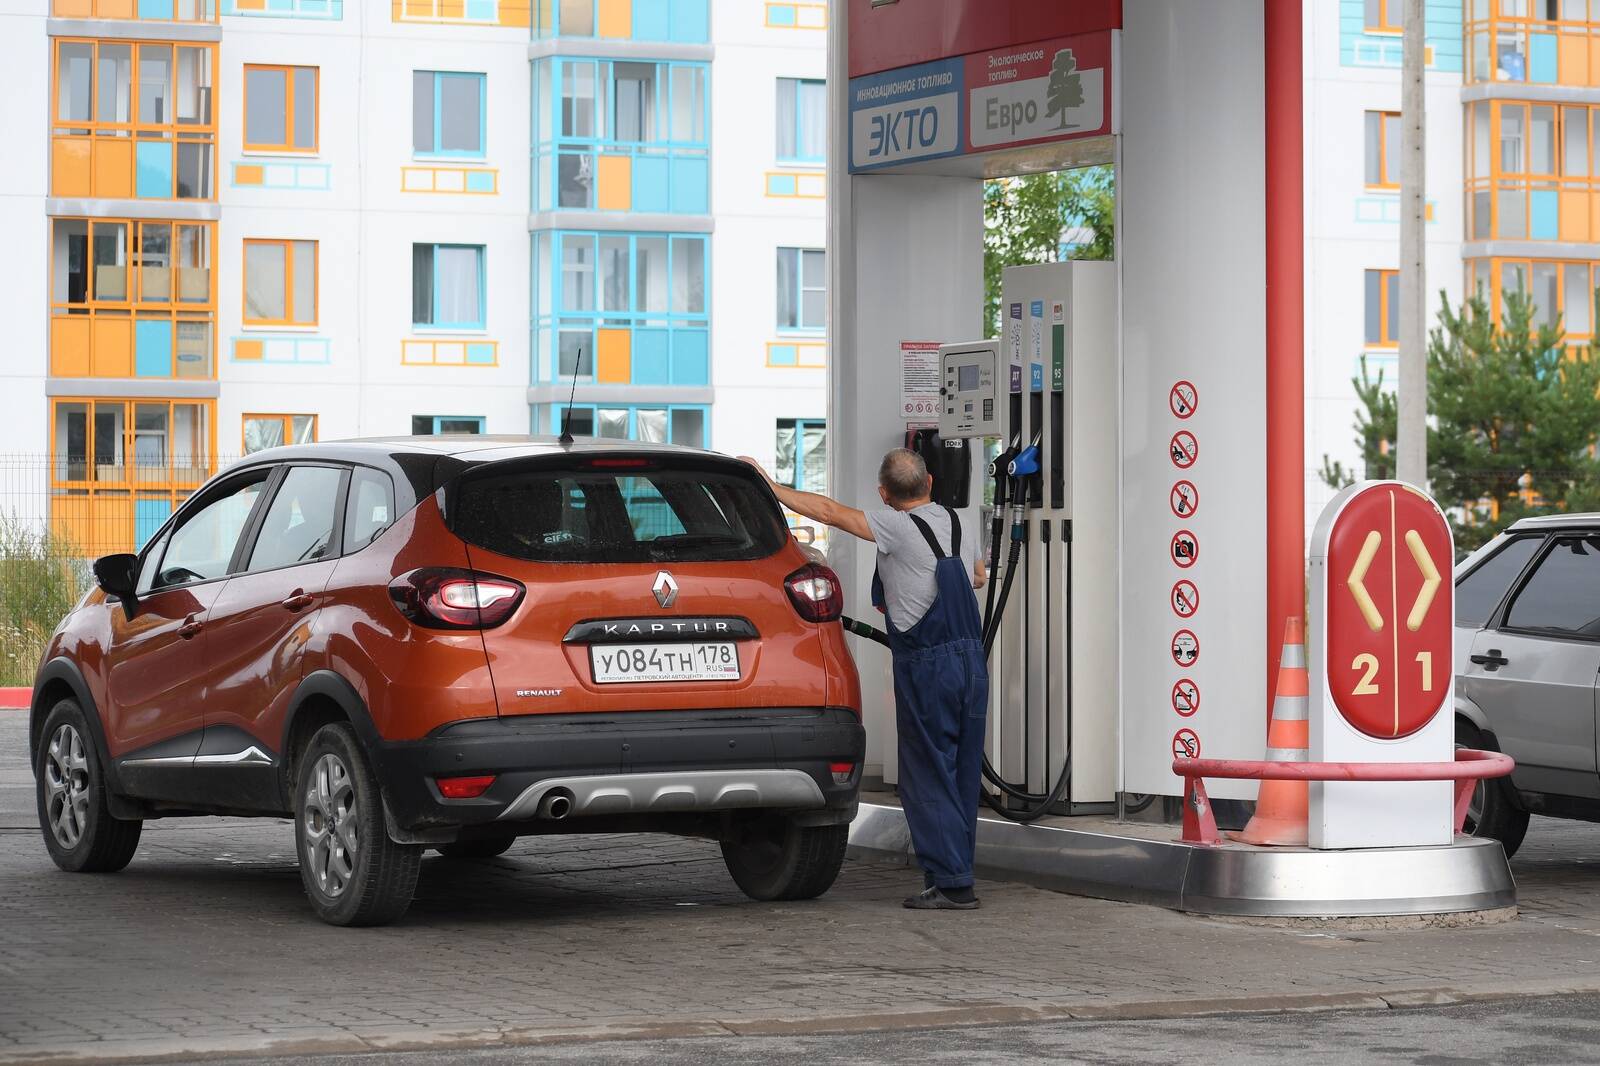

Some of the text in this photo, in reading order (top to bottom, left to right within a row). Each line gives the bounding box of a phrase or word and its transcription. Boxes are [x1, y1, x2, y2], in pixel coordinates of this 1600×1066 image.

[988, 50, 1044, 69] Экологическое
[988, 69, 1018, 83] топливо
[857, 71, 952, 102] ИННОВАЦИОННОЕ ТОПЛИВО
[986, 96, 1037, 136] Евро
[869, 106, 938, 157] ЭКТО
[1034, 369, 1041, 380] 92
[1054, 368, 1062, 379] 95
[604, 622, 729, 635] KAPTUR
[697, 645, 731, 664] 178
[706, 664, 724, 672] RUS
[1352, 653, 1379, 695] 2
[1415, 652, 1432, 691] 1
[516, 689, 562, 697] RENAULT
